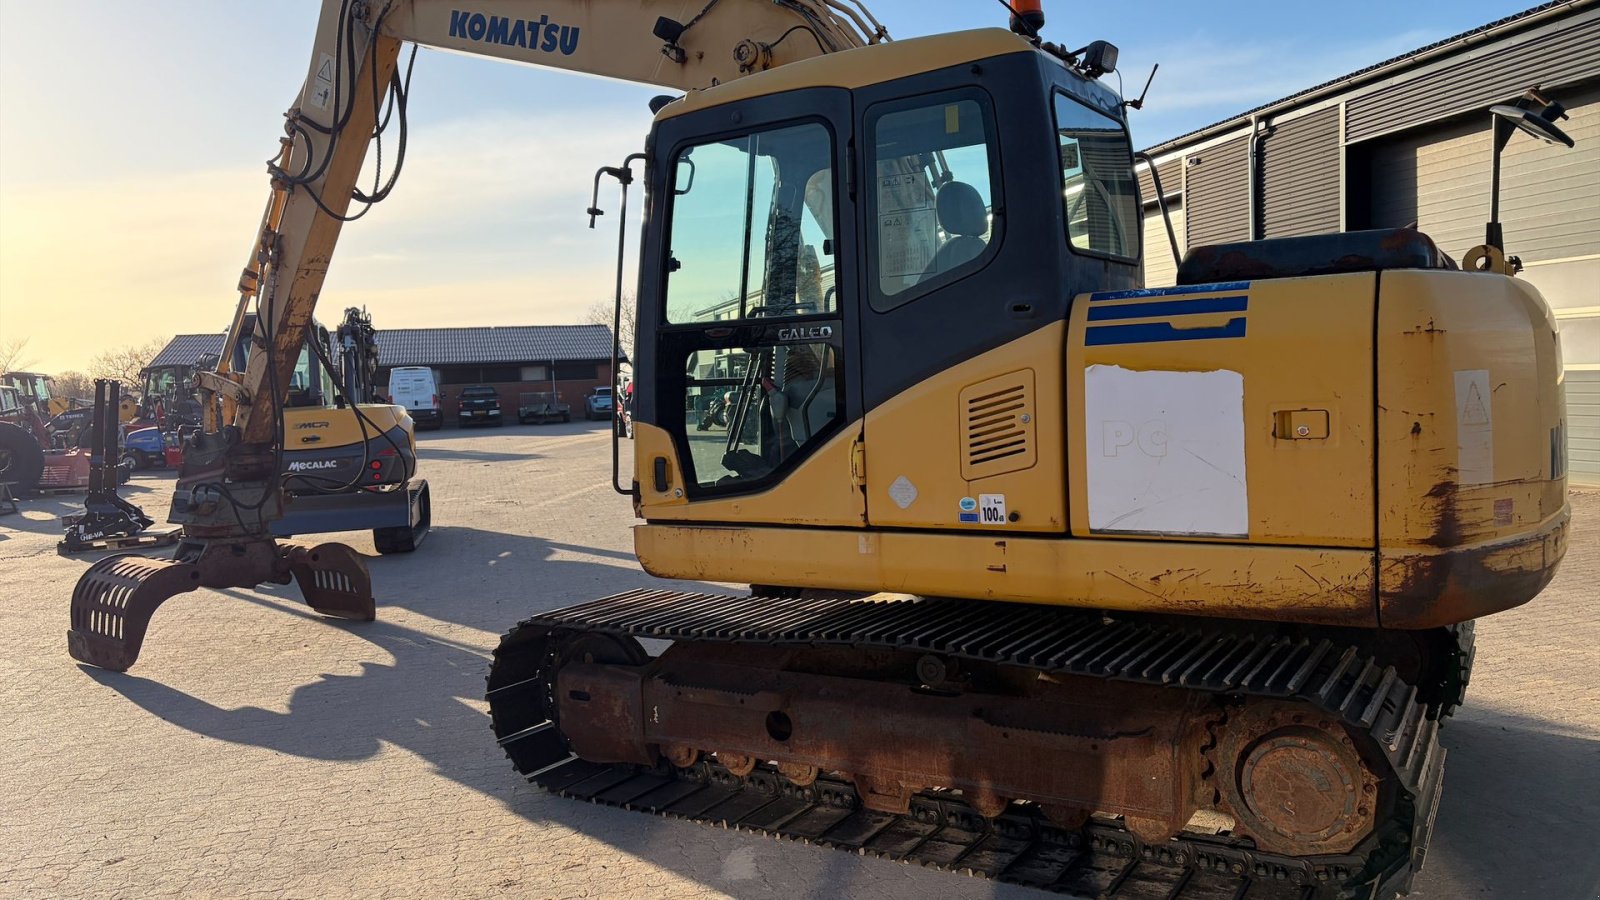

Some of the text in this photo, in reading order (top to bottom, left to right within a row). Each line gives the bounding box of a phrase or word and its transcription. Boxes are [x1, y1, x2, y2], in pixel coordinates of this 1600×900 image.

[449, 10, 580, 55] KOMATSU
[778, 326, 832, 341] GALEO
[983, 507, 999, 521] 100
